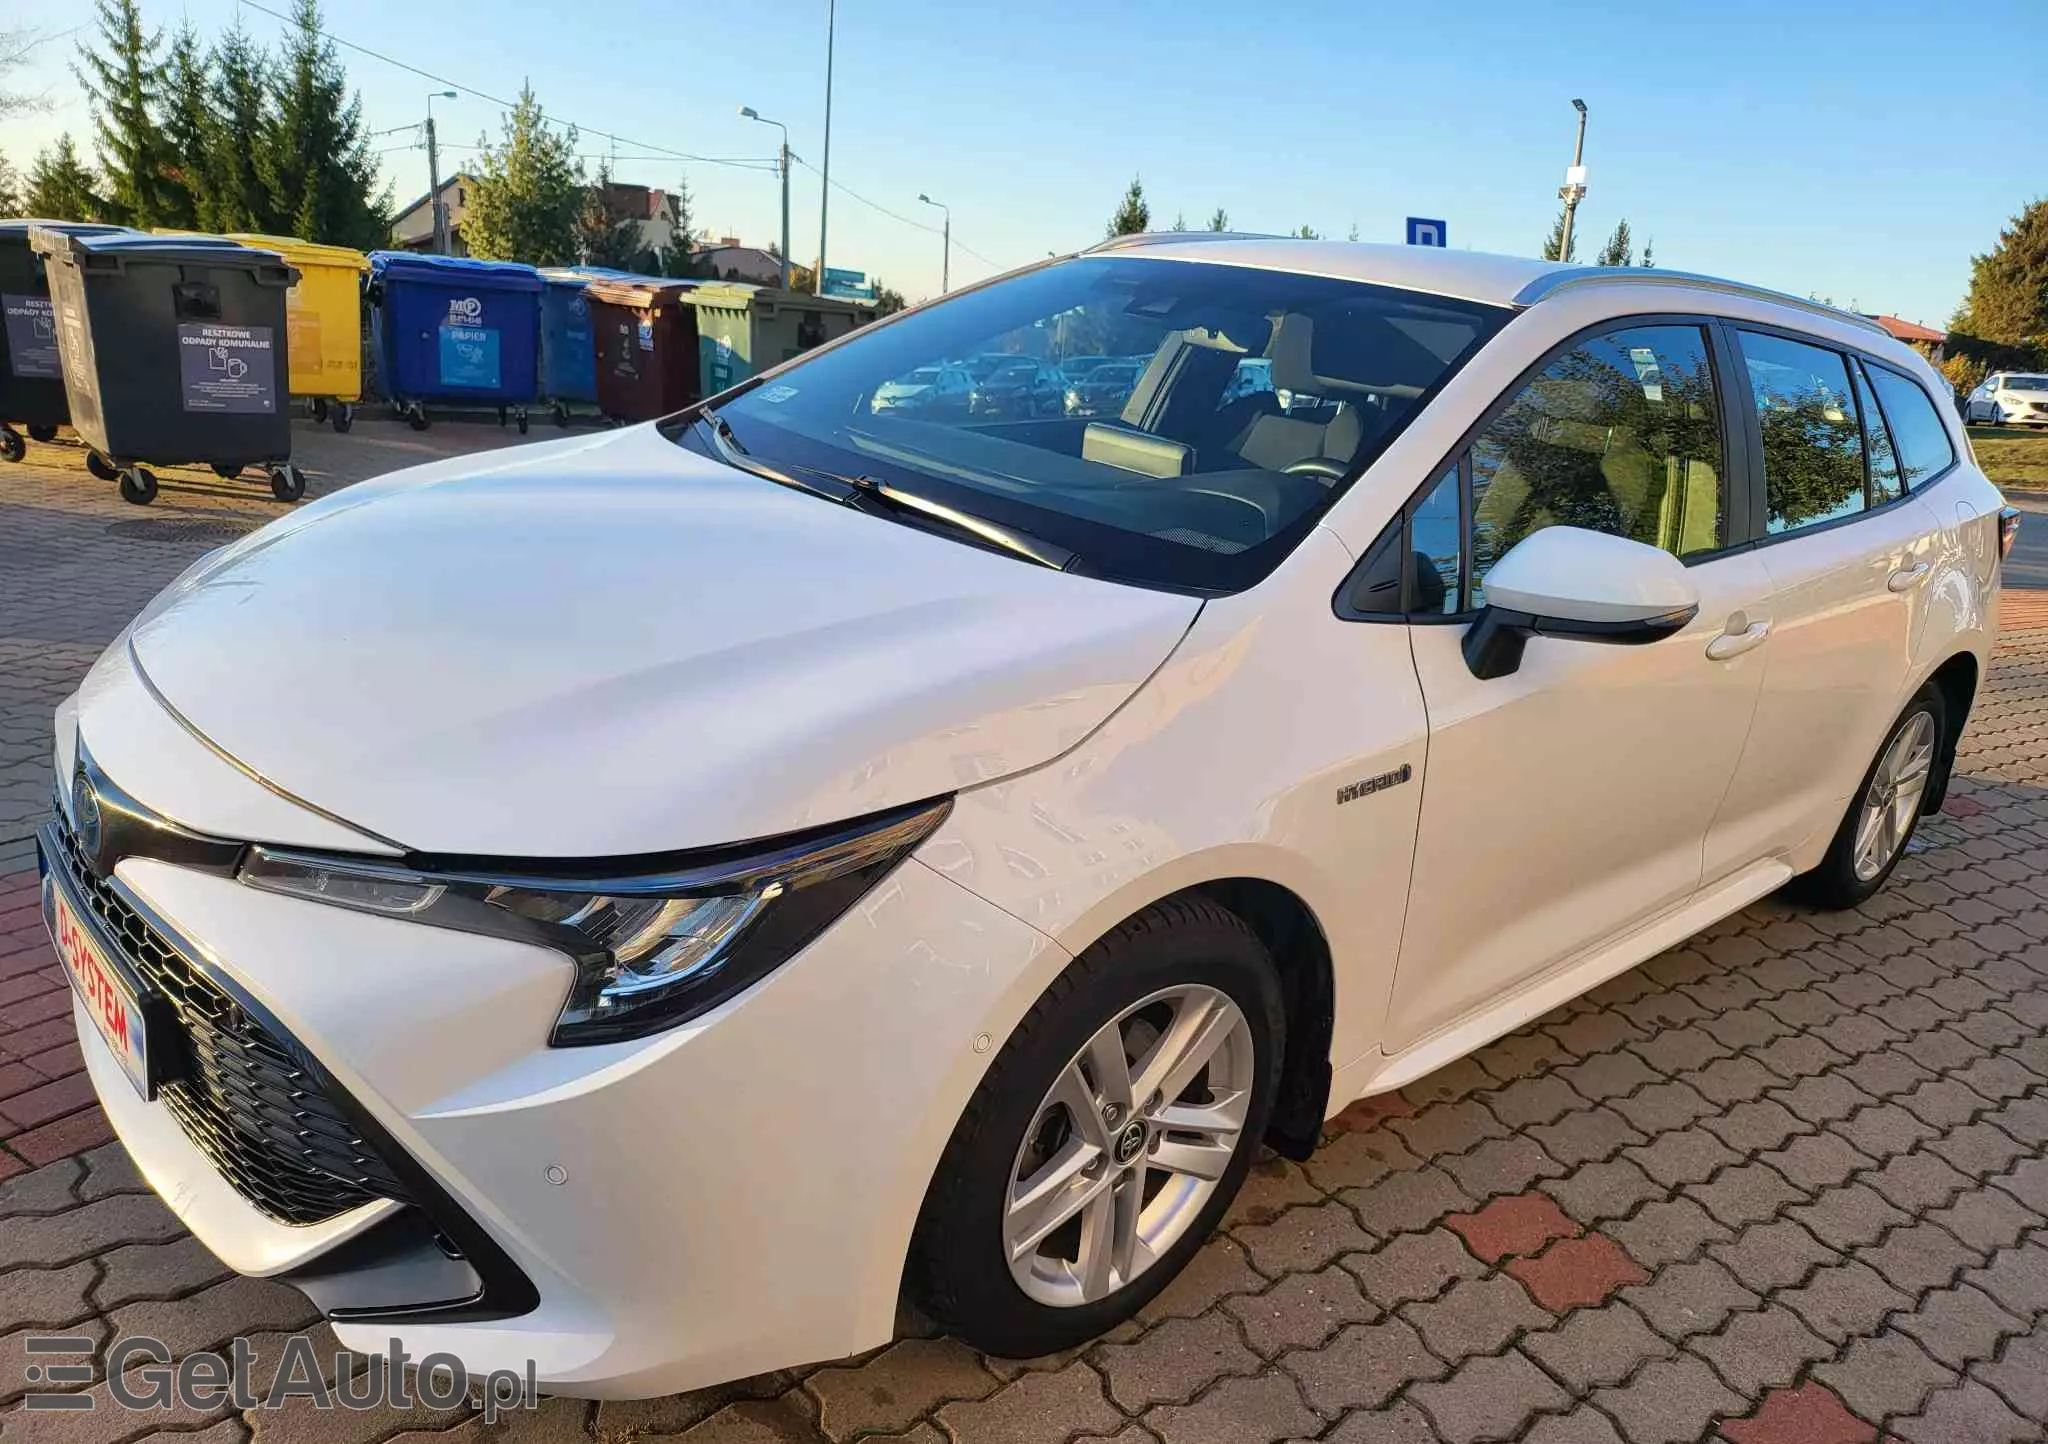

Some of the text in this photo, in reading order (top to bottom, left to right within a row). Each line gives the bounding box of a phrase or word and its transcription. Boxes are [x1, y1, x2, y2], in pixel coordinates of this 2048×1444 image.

[202, 328, 251, 339] RESZTKOWE
[451, 330, 486, 342] PAPIER
[182, 336, 271, 349] ODPADY KOMUNALNE
[1337, 763, 1411, 804] HYBRID
[60, 903, 129, 1053] D-SYSTEM
